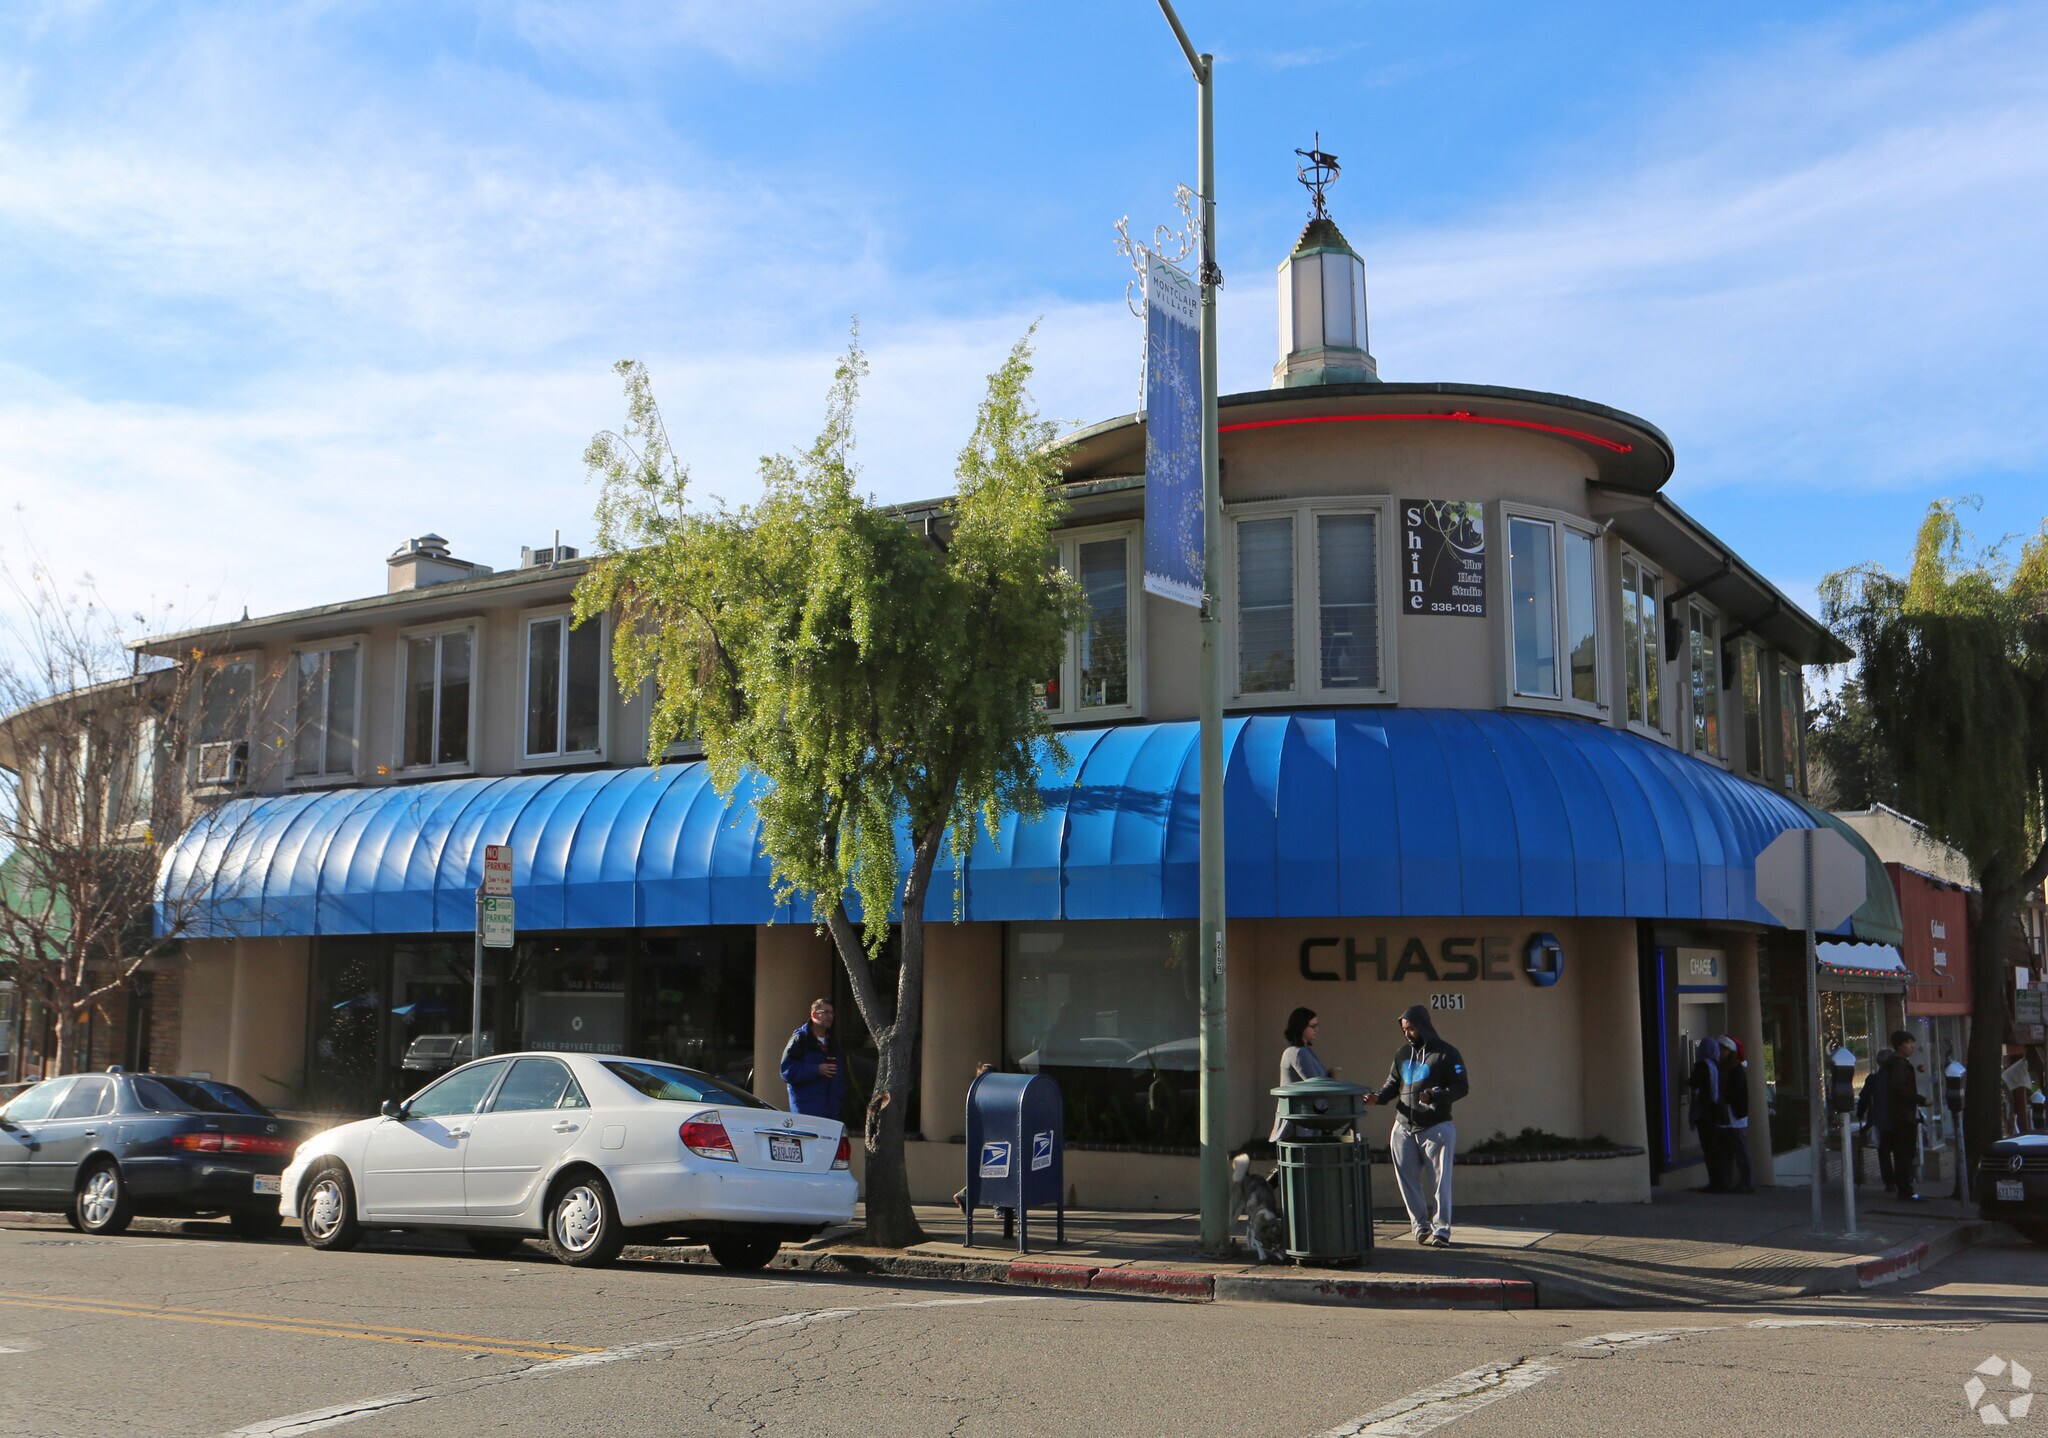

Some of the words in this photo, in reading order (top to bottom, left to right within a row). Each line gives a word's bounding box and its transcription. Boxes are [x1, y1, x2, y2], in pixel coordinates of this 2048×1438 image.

[1153, 276, 1197, 310] MONTCLAIR
[1157, 291, 1194, 318] VILLAGE
[1463, 559, 1482, 570] The
[1458, 572, 1482, 583] Hair
[1452, 585, 1482, 596] Studio
[1431, 602, 1482, 613] 336-1036
[486, 848, 498, 859] NO
[486, 861, 511, 871] PARKING
[487, 899, 495, 910] 2
[486, 914, 512, 924] PARKING
[1300, 937, 1515, 981] CHASE
[1690, 958, 1712, 975] CHASE
[1431, 995, 1464, 1010] 2051
[531, 1041, 556, 1049] CHASE
[559, 1042, 593, 1051] PRIVATE
